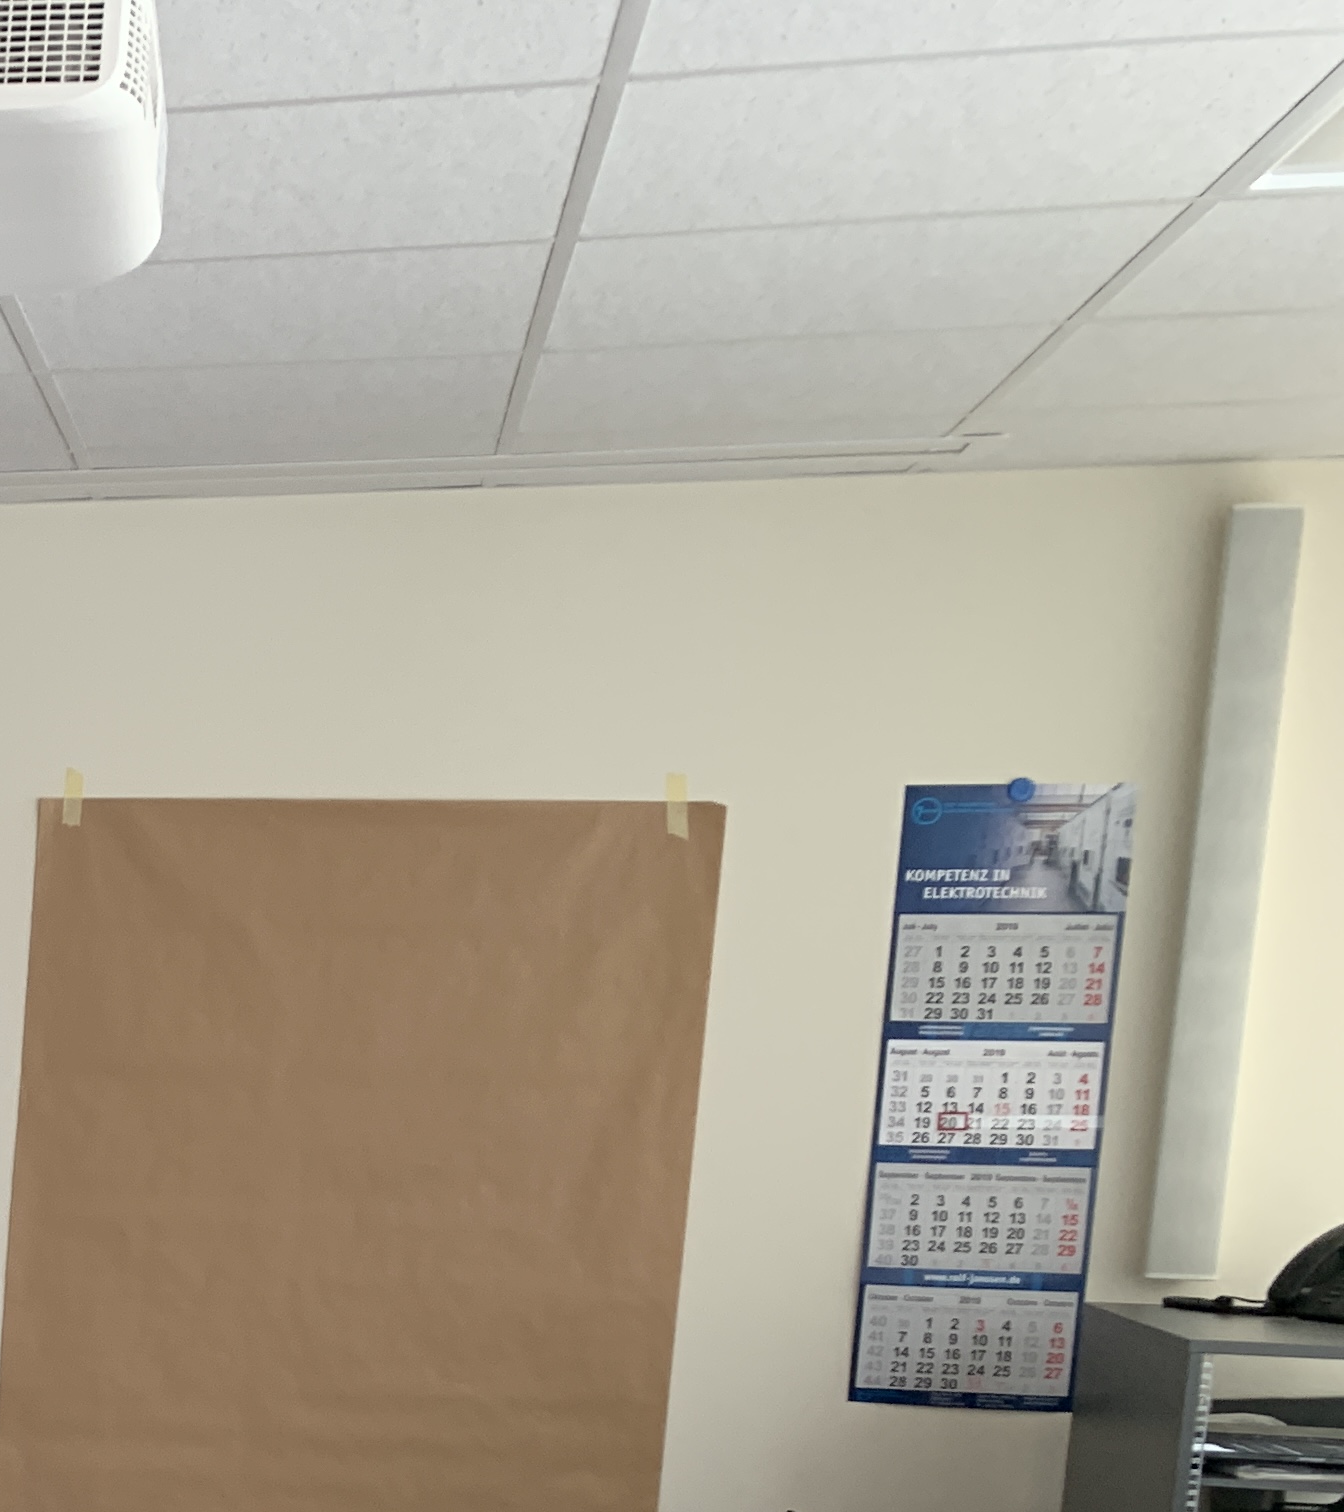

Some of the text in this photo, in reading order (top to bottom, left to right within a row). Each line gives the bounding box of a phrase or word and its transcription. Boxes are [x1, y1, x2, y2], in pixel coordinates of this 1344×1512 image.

[905, 870, 1009, 882] KOMPETENZ IN
[923, 887, 1047, 899] ELEKTROTECHNIK
[933, 962, 1105, 974] 8 9 10 11 12 14
[929, 977, 1102, 989] 15 16 17 18 19 21
[925, 993, 1102, 1006] 22 23 24 25 26 28
